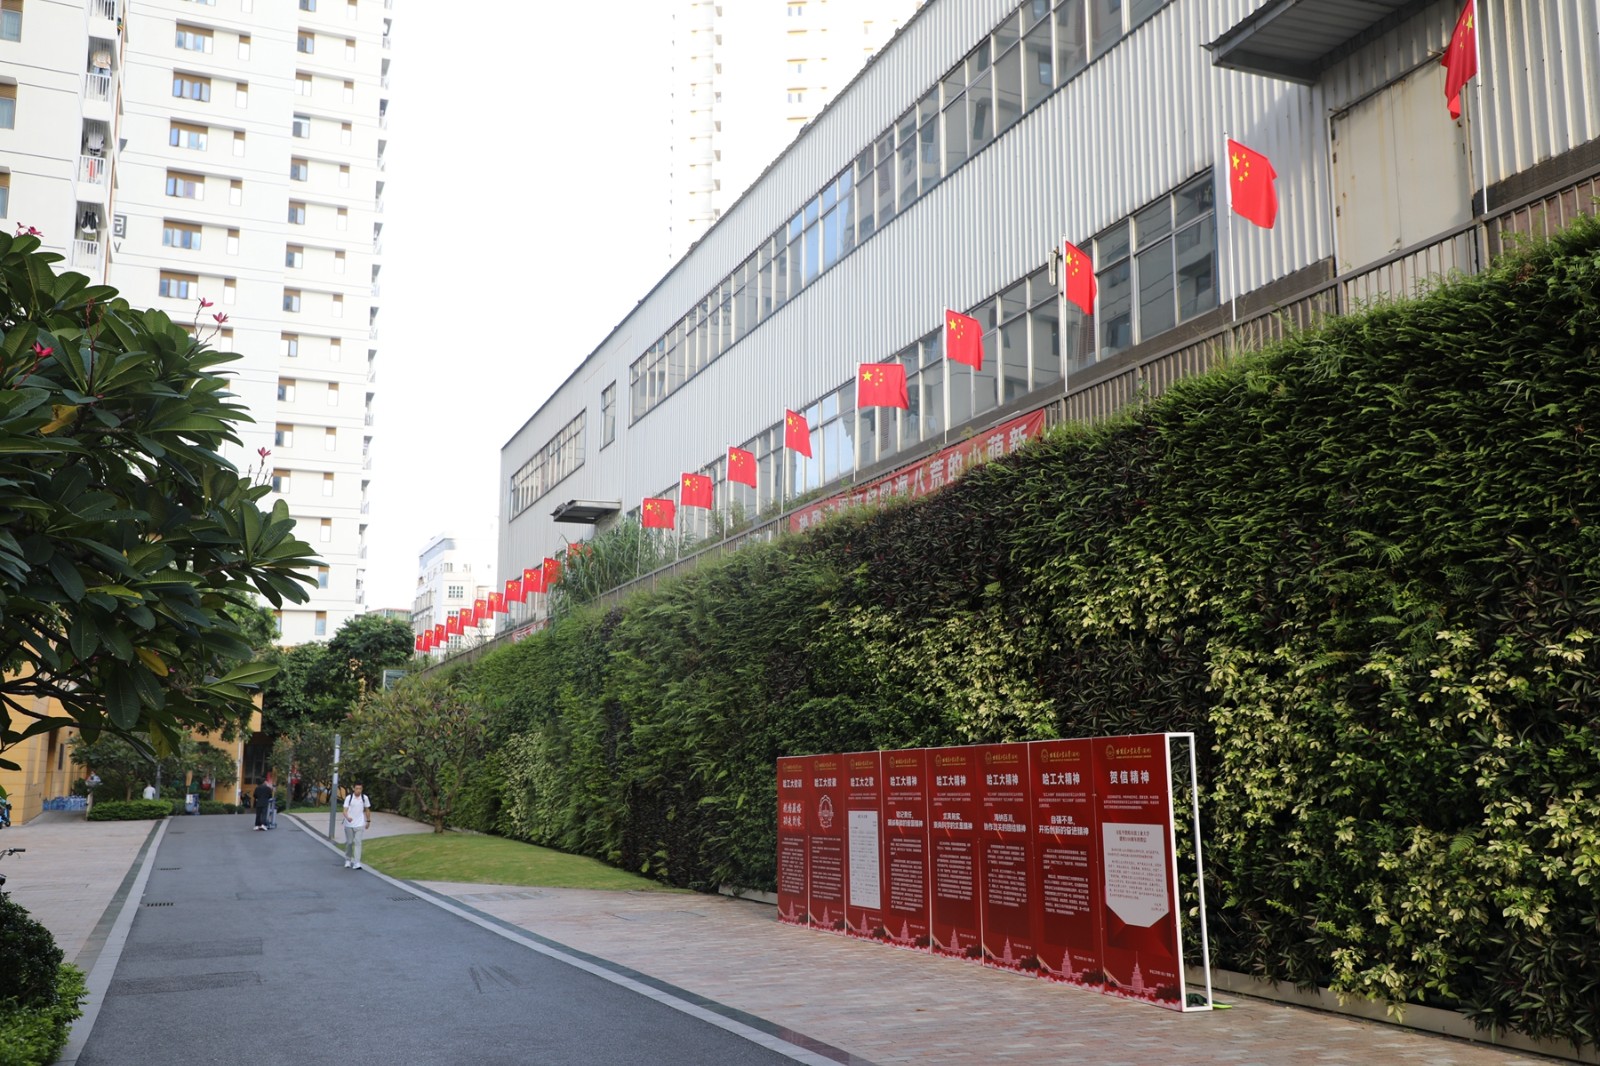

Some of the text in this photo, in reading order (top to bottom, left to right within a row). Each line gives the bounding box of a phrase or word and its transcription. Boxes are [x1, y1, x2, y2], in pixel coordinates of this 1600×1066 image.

[850, 776, 874, 787] 哈工大之歌
[890, 775, 917, 786] 哈工大精神
[936, 775, 966, 786] 哈工大精神
[986, 773, 1018, 785] 哈工大精神
[1042, 772, 1080, 785] 哈工大精神
[1109, 770, 1150, 784] 贺信精神
